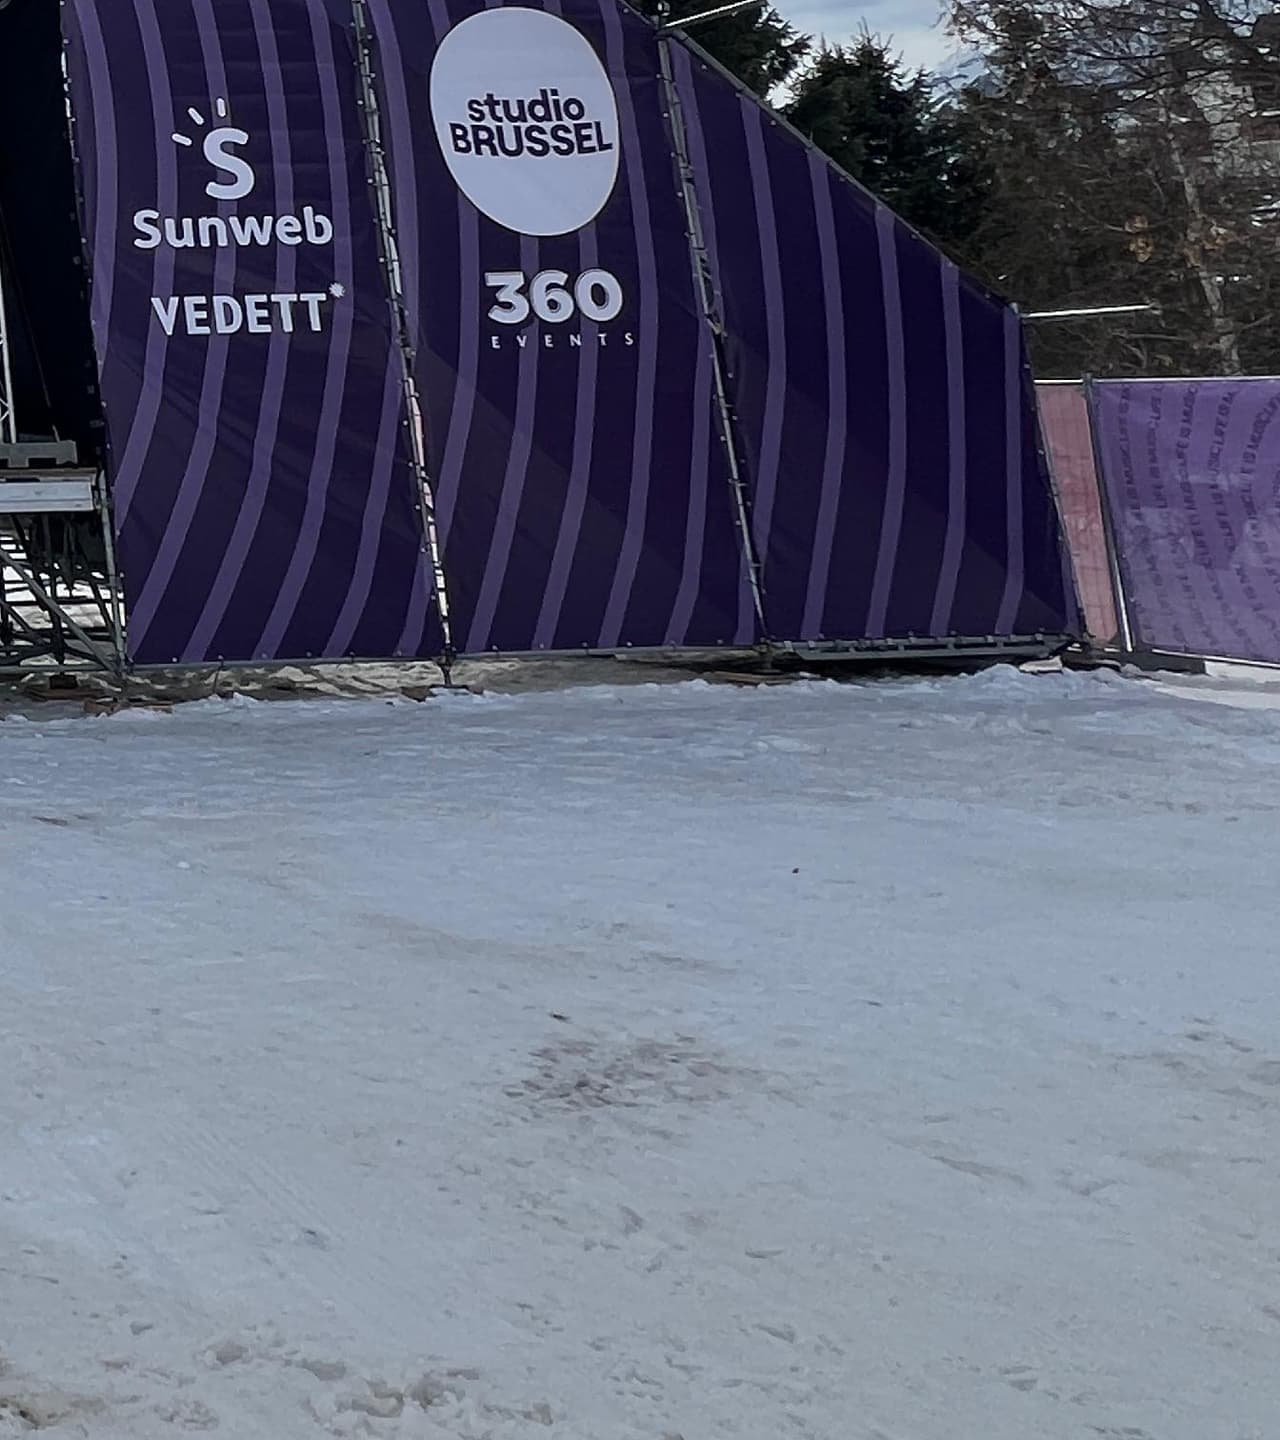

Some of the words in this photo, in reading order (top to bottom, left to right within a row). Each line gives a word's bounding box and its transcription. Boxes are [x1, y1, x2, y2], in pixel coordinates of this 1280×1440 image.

[467, 89, 586, 123] studio
[448, 122, 614, 158] BRUSSEL
[132, 206, 334, 249] Sunweb
[484, 268, 624, 325] 360
[490, 332, 635, 350] EVENTS
